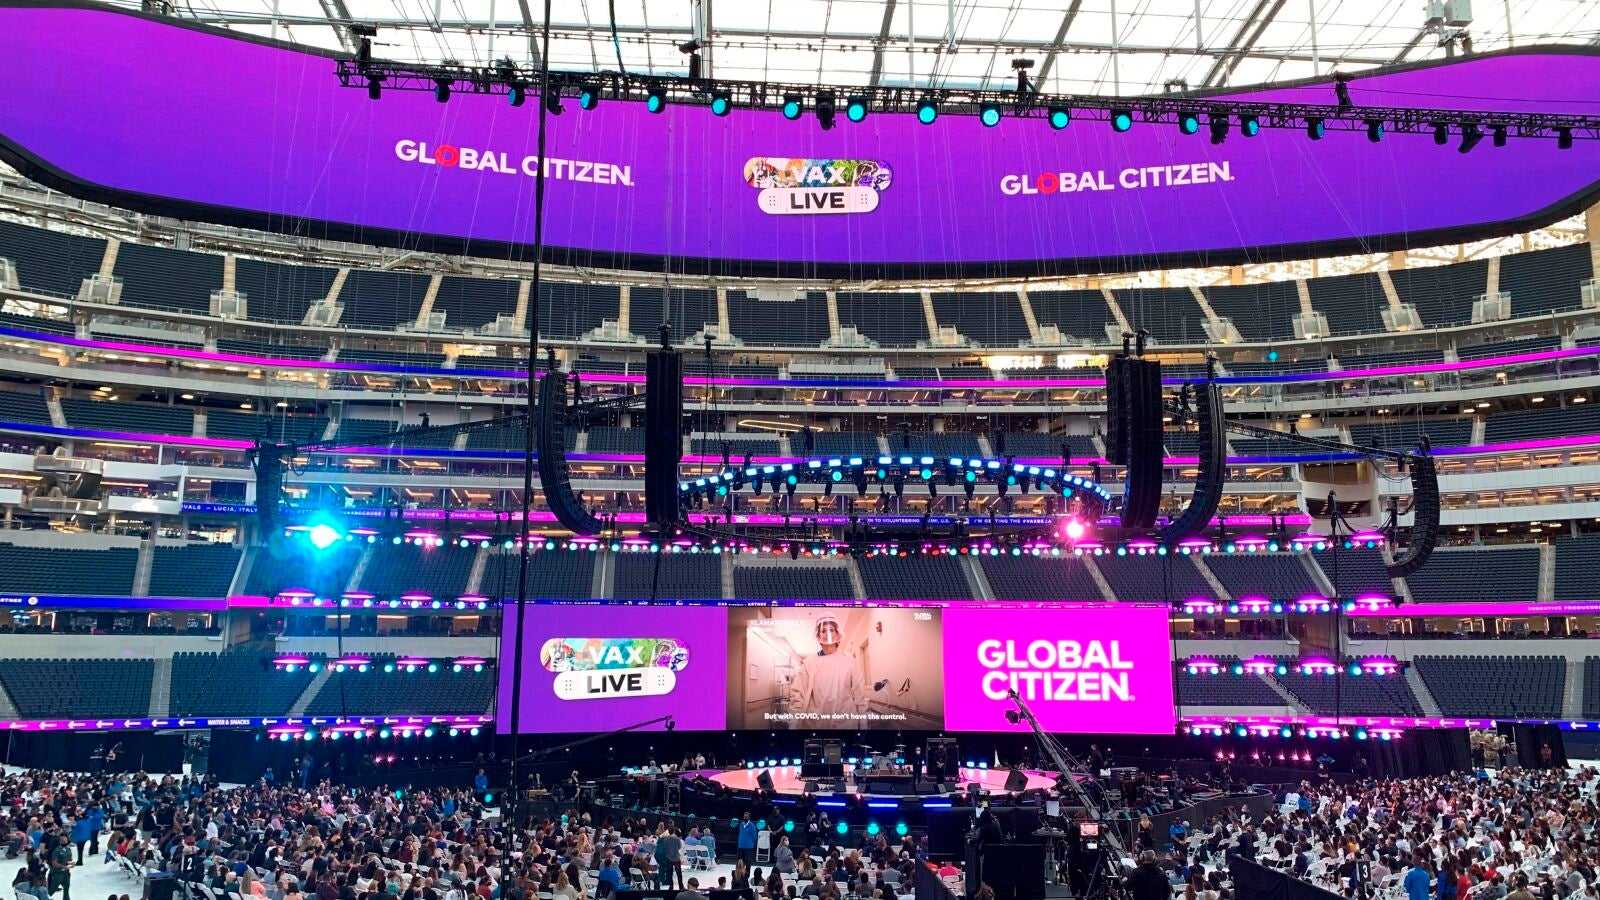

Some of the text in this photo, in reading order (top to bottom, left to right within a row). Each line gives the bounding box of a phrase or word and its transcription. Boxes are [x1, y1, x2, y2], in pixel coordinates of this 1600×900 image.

[395, 139, 516, 174] GLOBAL
[790, 166, 847, 184] VAX
[1000, 170, 1115, 195] GLOBAL
[790, 192, 845, 209] LIVE
[588, 645, 645, 665] VAX
[977, 639, 1135, 669] GLOBAL
[587, 673, 643, 694] LIVE
[764, 712, 776, 720] But
[777, 712, 793, 720] with
[795, 712, 820, 721] COVID,
[831, 712, 850, 720] don't
[850, 712, 868, 720] have
[868, 712, 880, 720] the
[880, 712, 907, 720] control.
[187, 857, 193, 871] 2
[1362, 864, 1369, 879] 3
